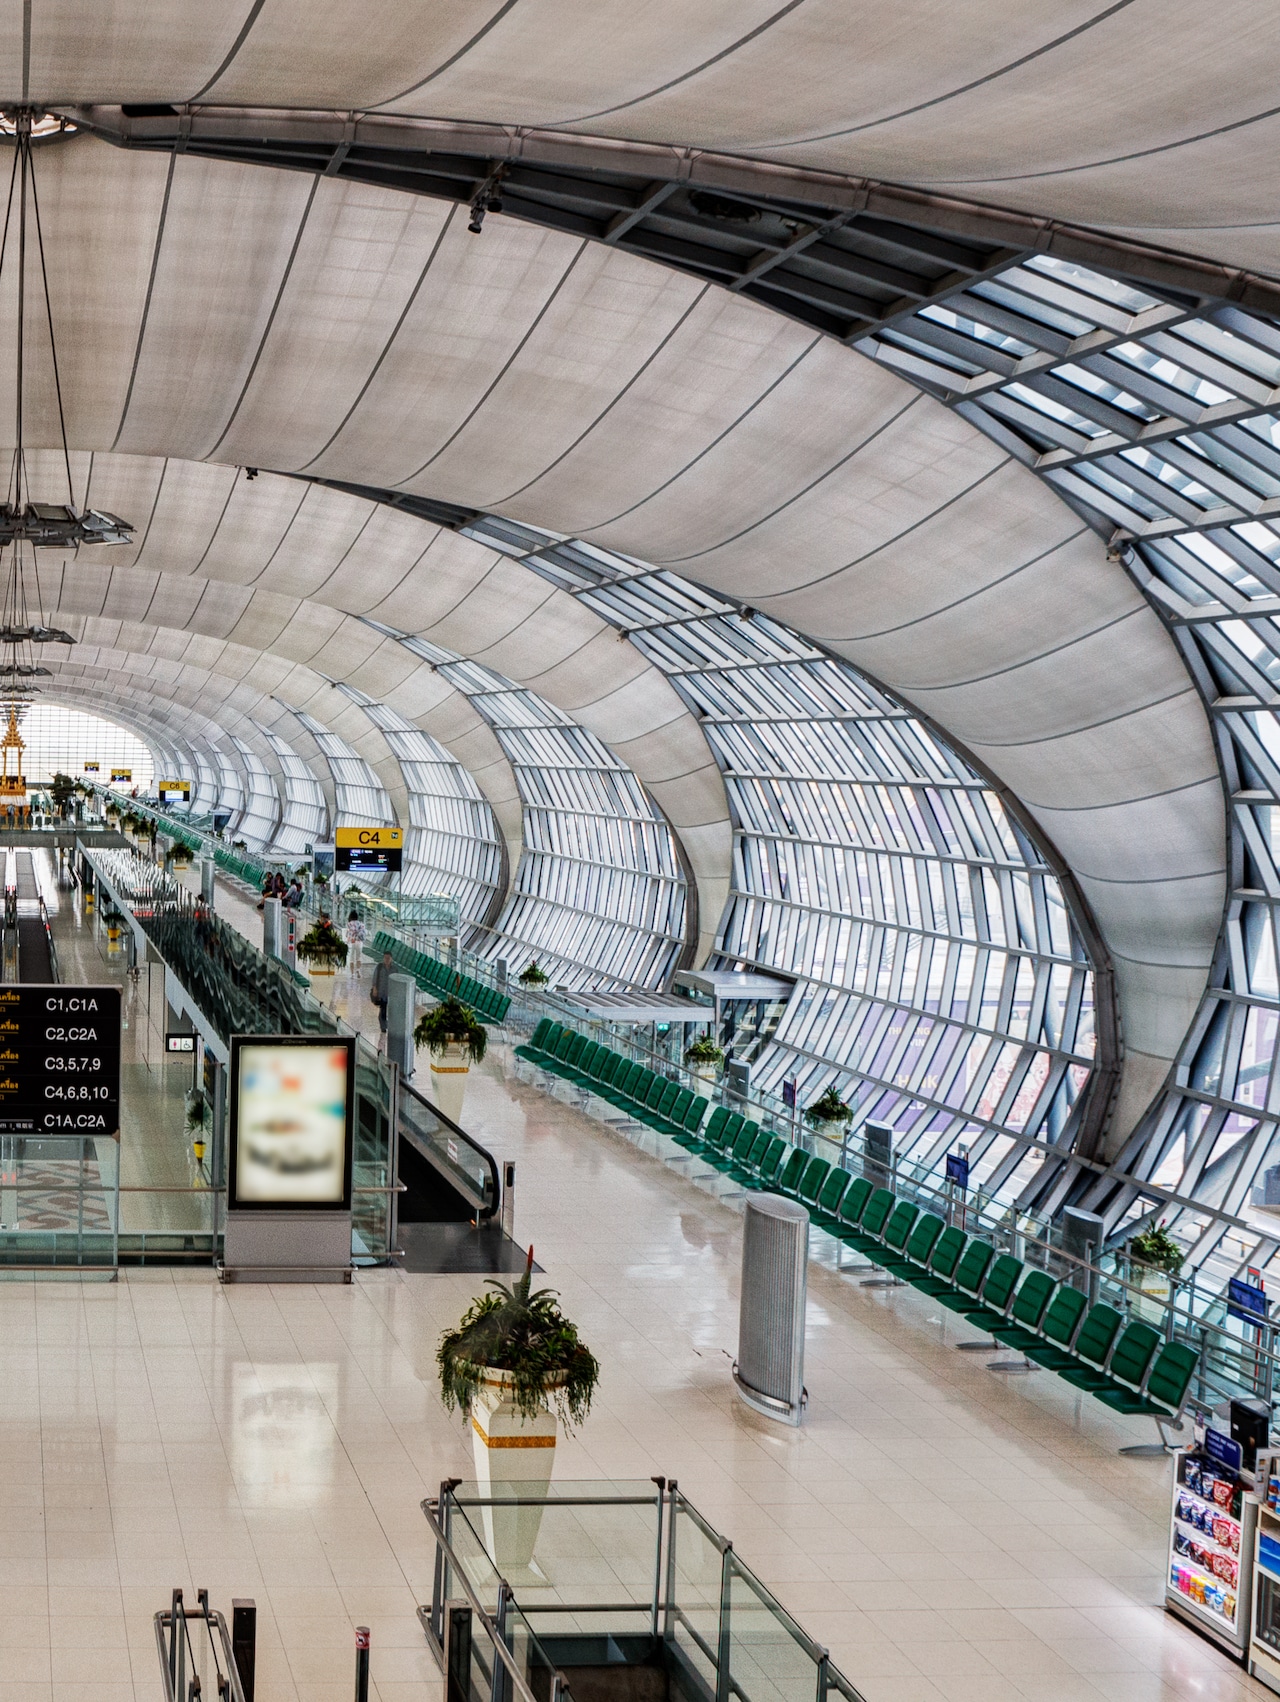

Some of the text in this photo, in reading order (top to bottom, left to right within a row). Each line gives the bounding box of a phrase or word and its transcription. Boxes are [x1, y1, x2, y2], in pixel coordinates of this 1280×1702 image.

[169, 782, 180, 790] C6
[358, 831, 380, 845] C4
[45, 998, 98, 1013] C1,C1A
[45, 1027, 98, 1042] C2,C2A
[44, 1057, 101, 1072] C3,5,7,9
[44, 1085, 109, 1101] C4,6,8,10
[43, 1114, 106, 1129] C1A,C2A
